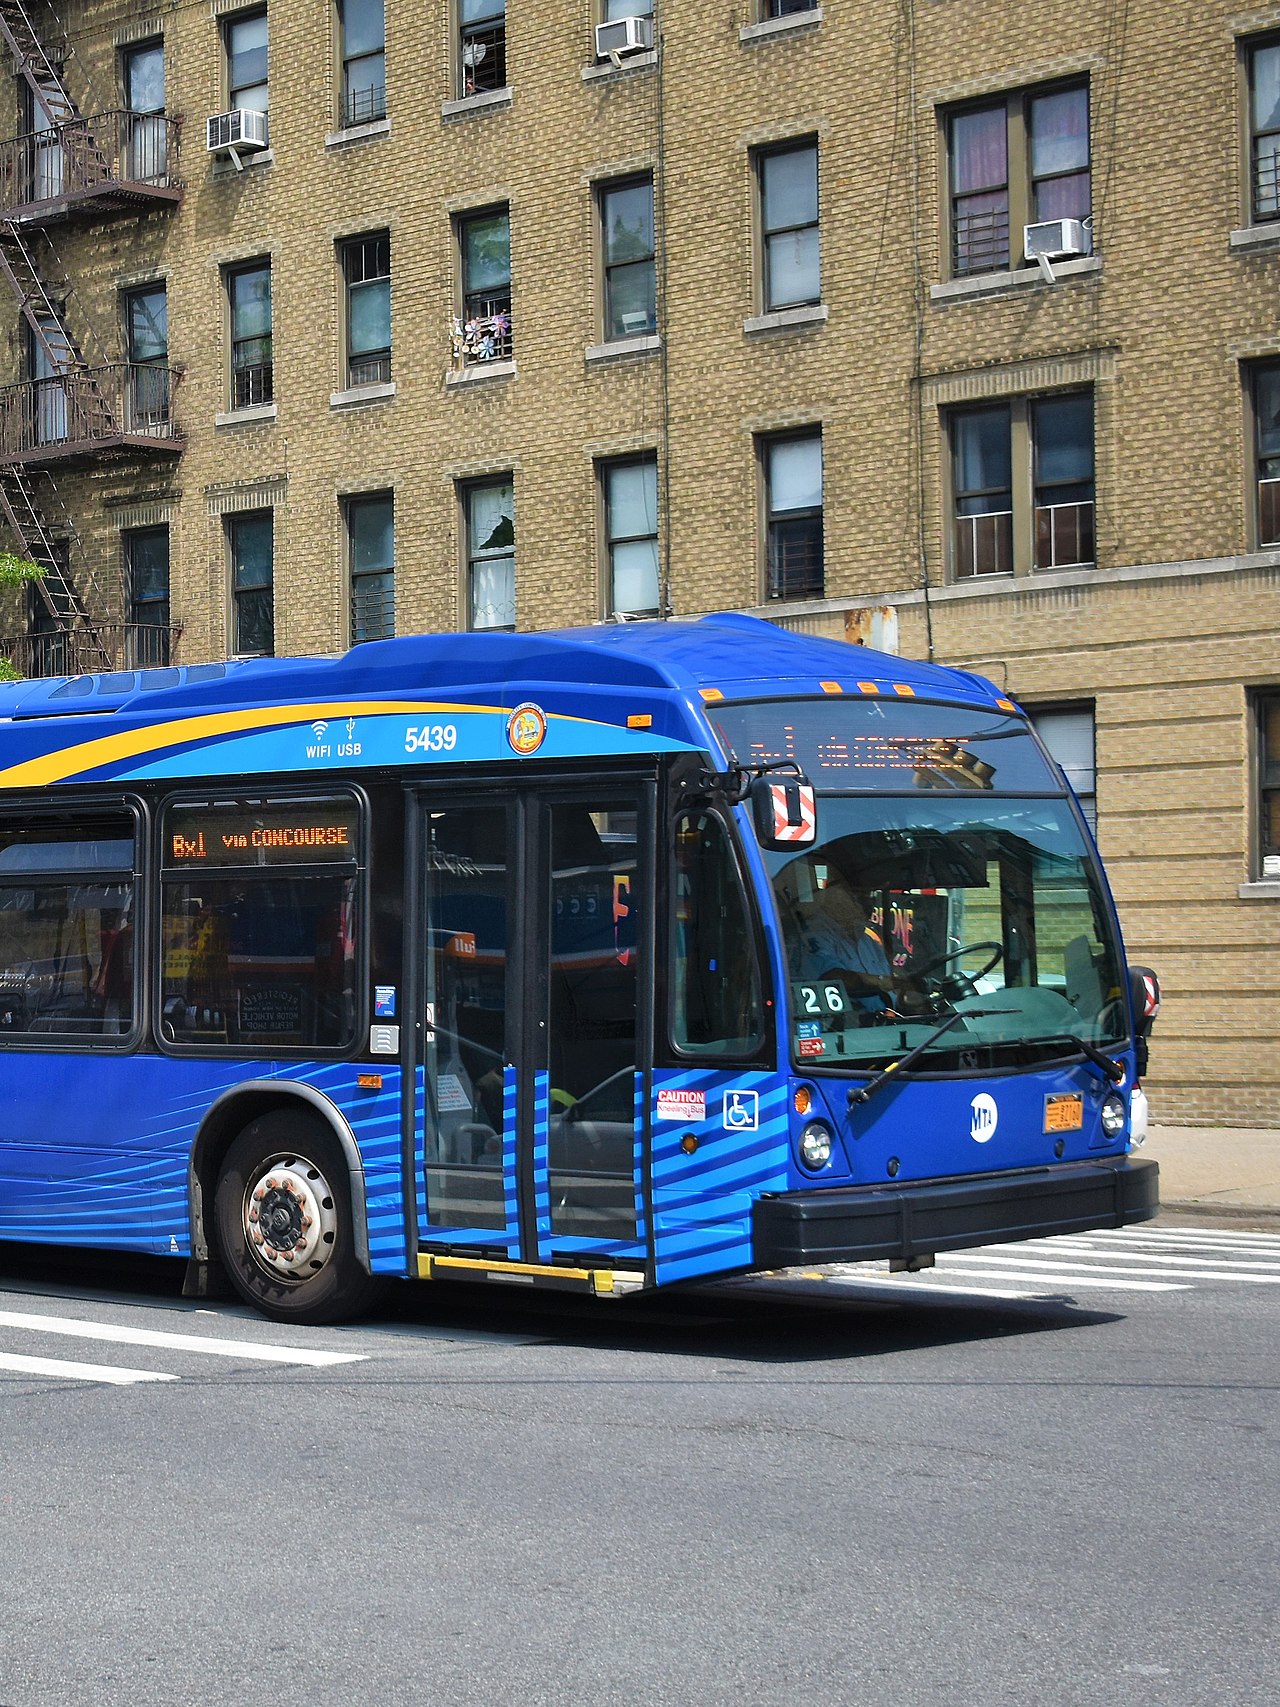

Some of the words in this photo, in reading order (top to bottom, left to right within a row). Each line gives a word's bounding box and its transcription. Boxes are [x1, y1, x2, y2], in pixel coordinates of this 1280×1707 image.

[404, 724, 458, 753] 5439
[306, 745, 331, 758] WIFI
[337, 743, 362, 757] USB
[173, 832, 207, 858] Bx1
[251, 826, 349, 847] CONCOURSE
[658, 1090, 705, 1103] CAUTION
[658, 1105, 688, 1115] Kneeling
[690, 1105, 705, 1114] Bus
[970, 1106, 993, 1132] MTA
